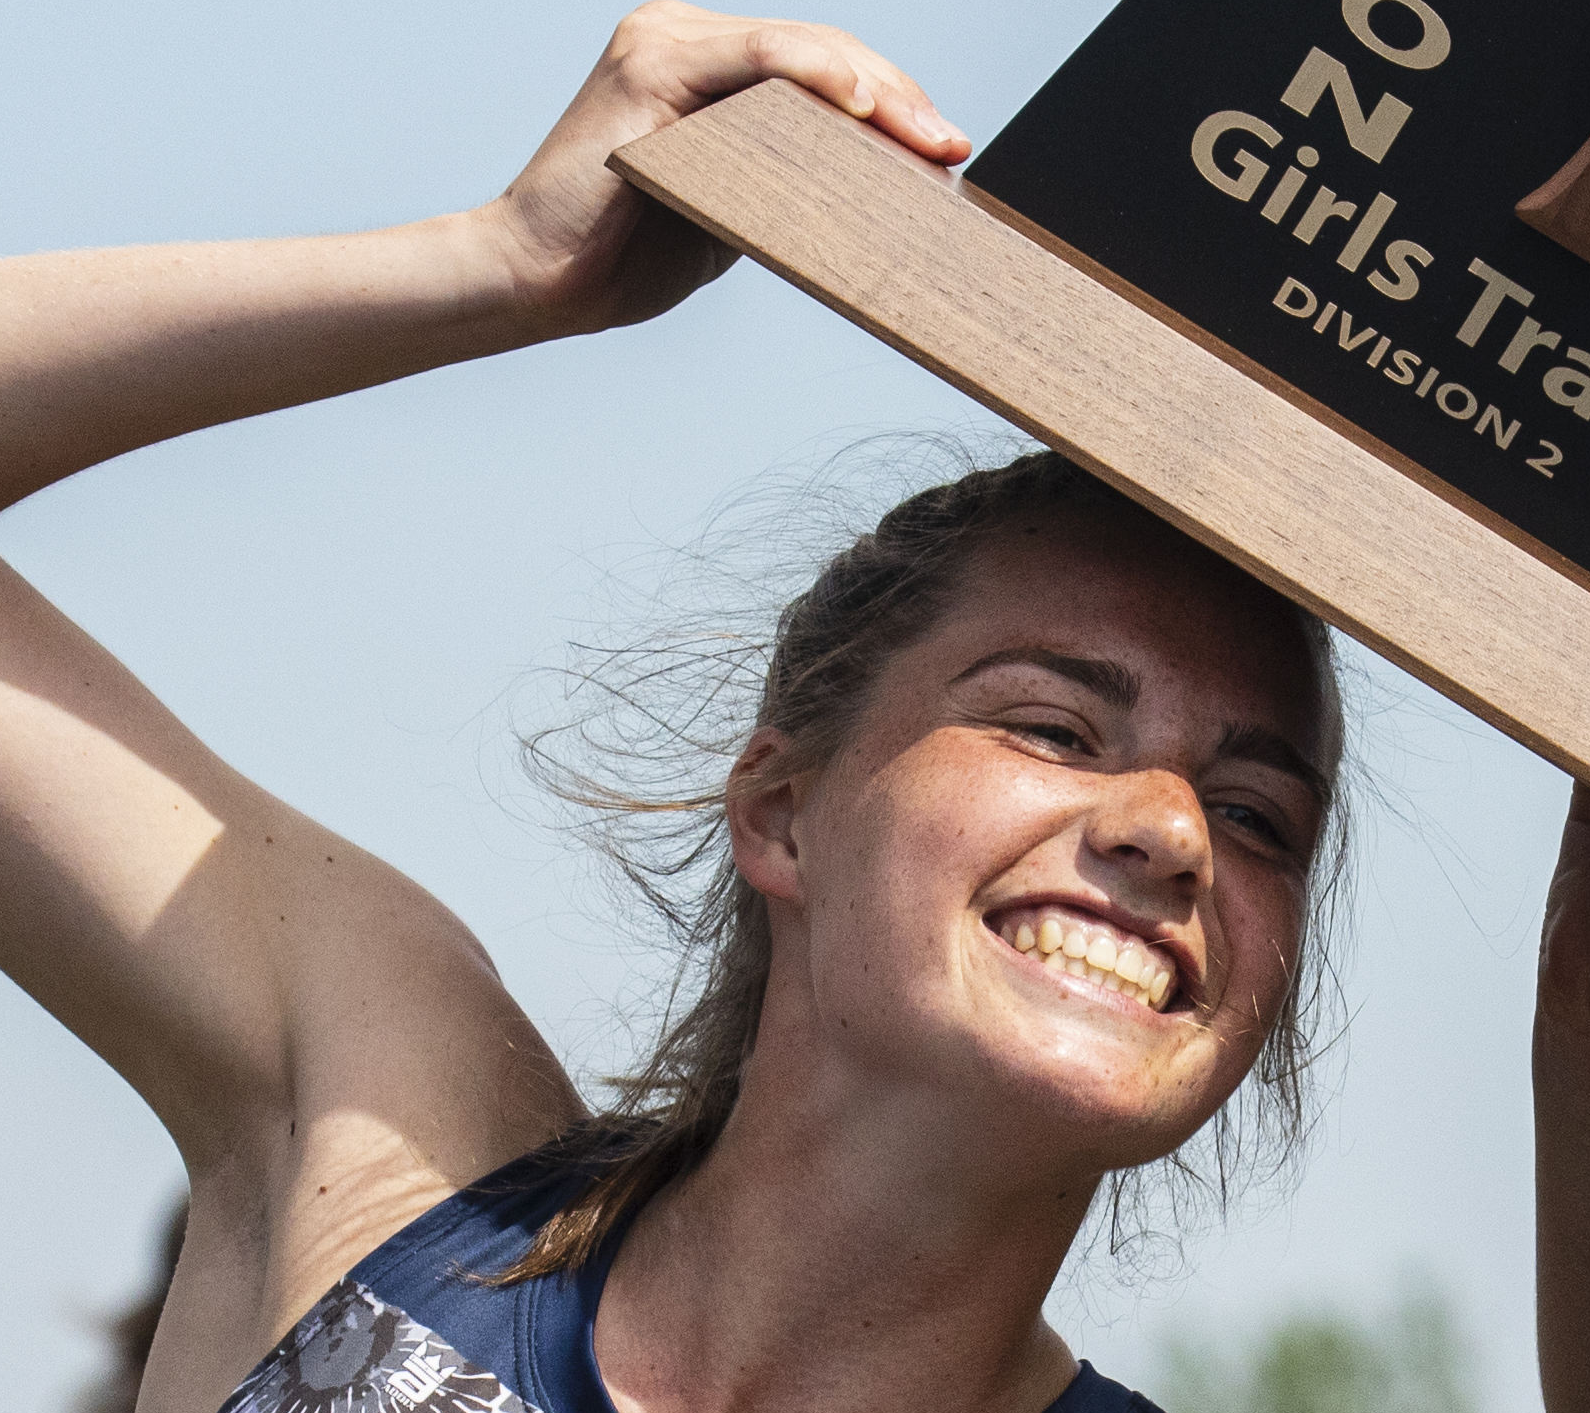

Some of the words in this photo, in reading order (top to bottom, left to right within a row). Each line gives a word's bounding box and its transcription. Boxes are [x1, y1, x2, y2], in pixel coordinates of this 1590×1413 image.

[1191, 110, 1434, 301] Girls
[1272, 276, 1521, 449] DIVISION
[1526, 440, 1563, 478] 2
